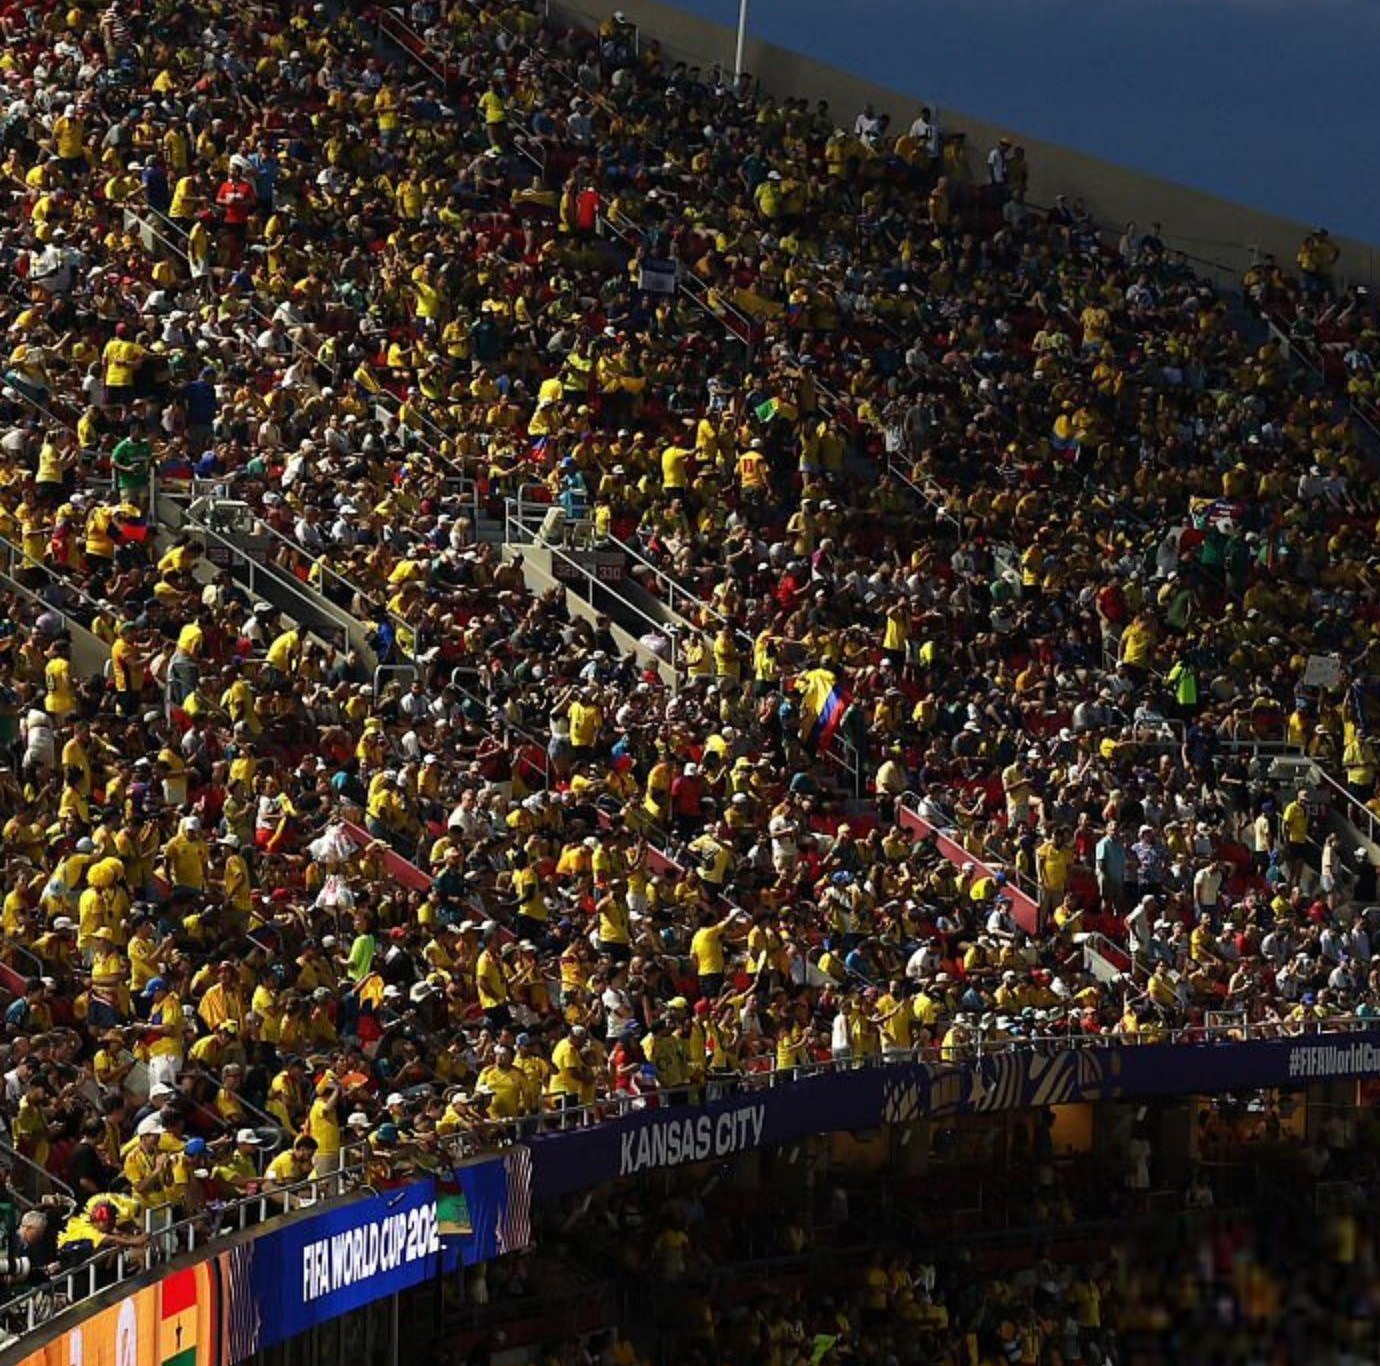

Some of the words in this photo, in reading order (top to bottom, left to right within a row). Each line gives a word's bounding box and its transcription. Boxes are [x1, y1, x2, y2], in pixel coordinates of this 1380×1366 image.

[620, 1115, 712, 1176] KANSAS
[715, 1104, 765, 1156] CITY
[303, 1238, 331, 1304] FIFA
[331, 1222, 380, 1291] WORLD
[380, 1212, 407, 1272] CUP
[405, 1200, 448, 1263] 202
